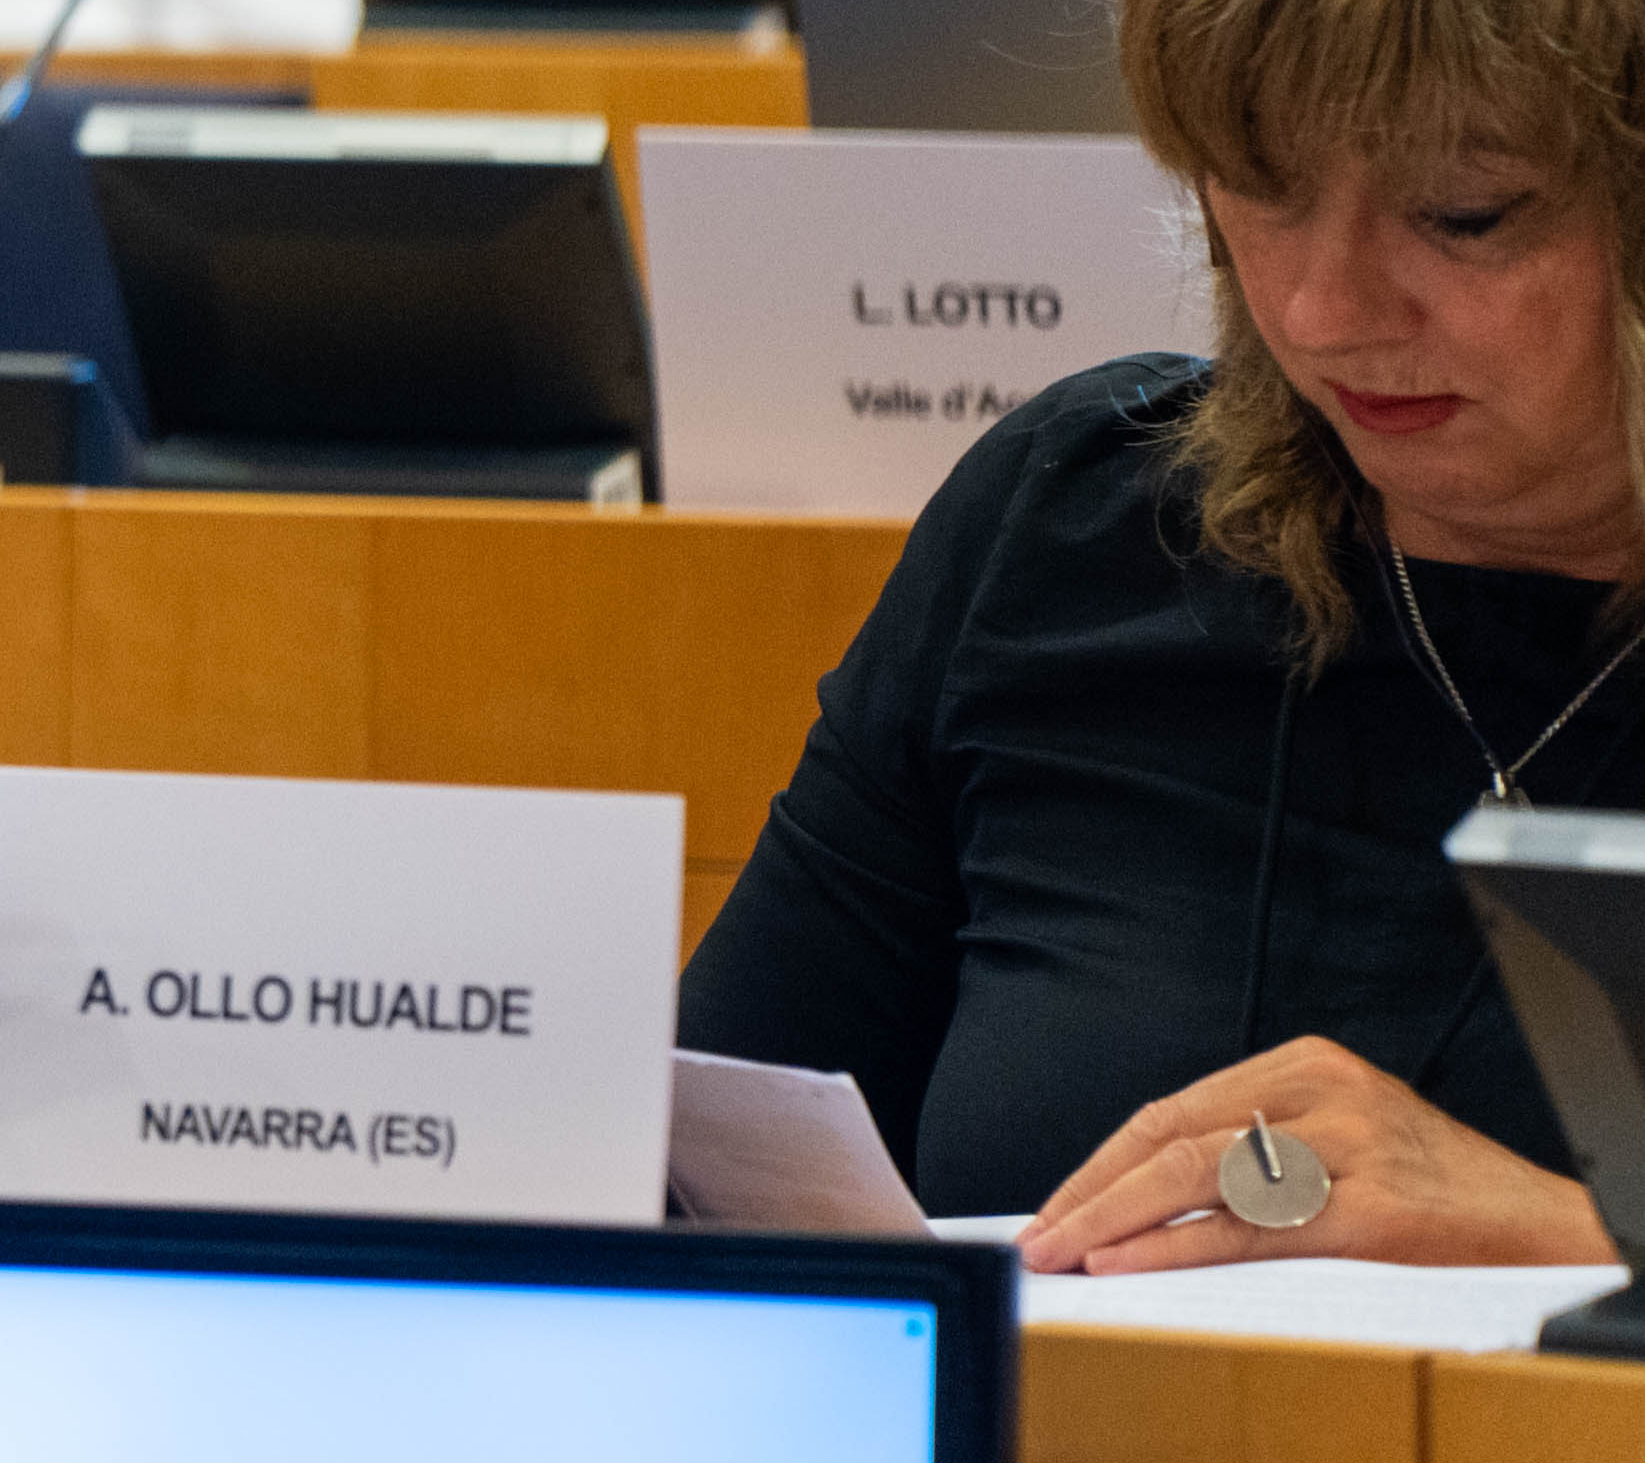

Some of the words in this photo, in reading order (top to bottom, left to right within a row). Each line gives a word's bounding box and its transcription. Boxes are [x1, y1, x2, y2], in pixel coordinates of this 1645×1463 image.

[904, 282, 1064, 331] LOTTO
[844, 379, 932, 419] Valle
[79, 967, 129, 1016] A.
[145, 969, 295, 1024] OLLO
[308, 980, 532, 1037] HUALDE
[140, 1101, 358, 1153] NAVARRA
[367, 1114, 457, 1169] (ES)
